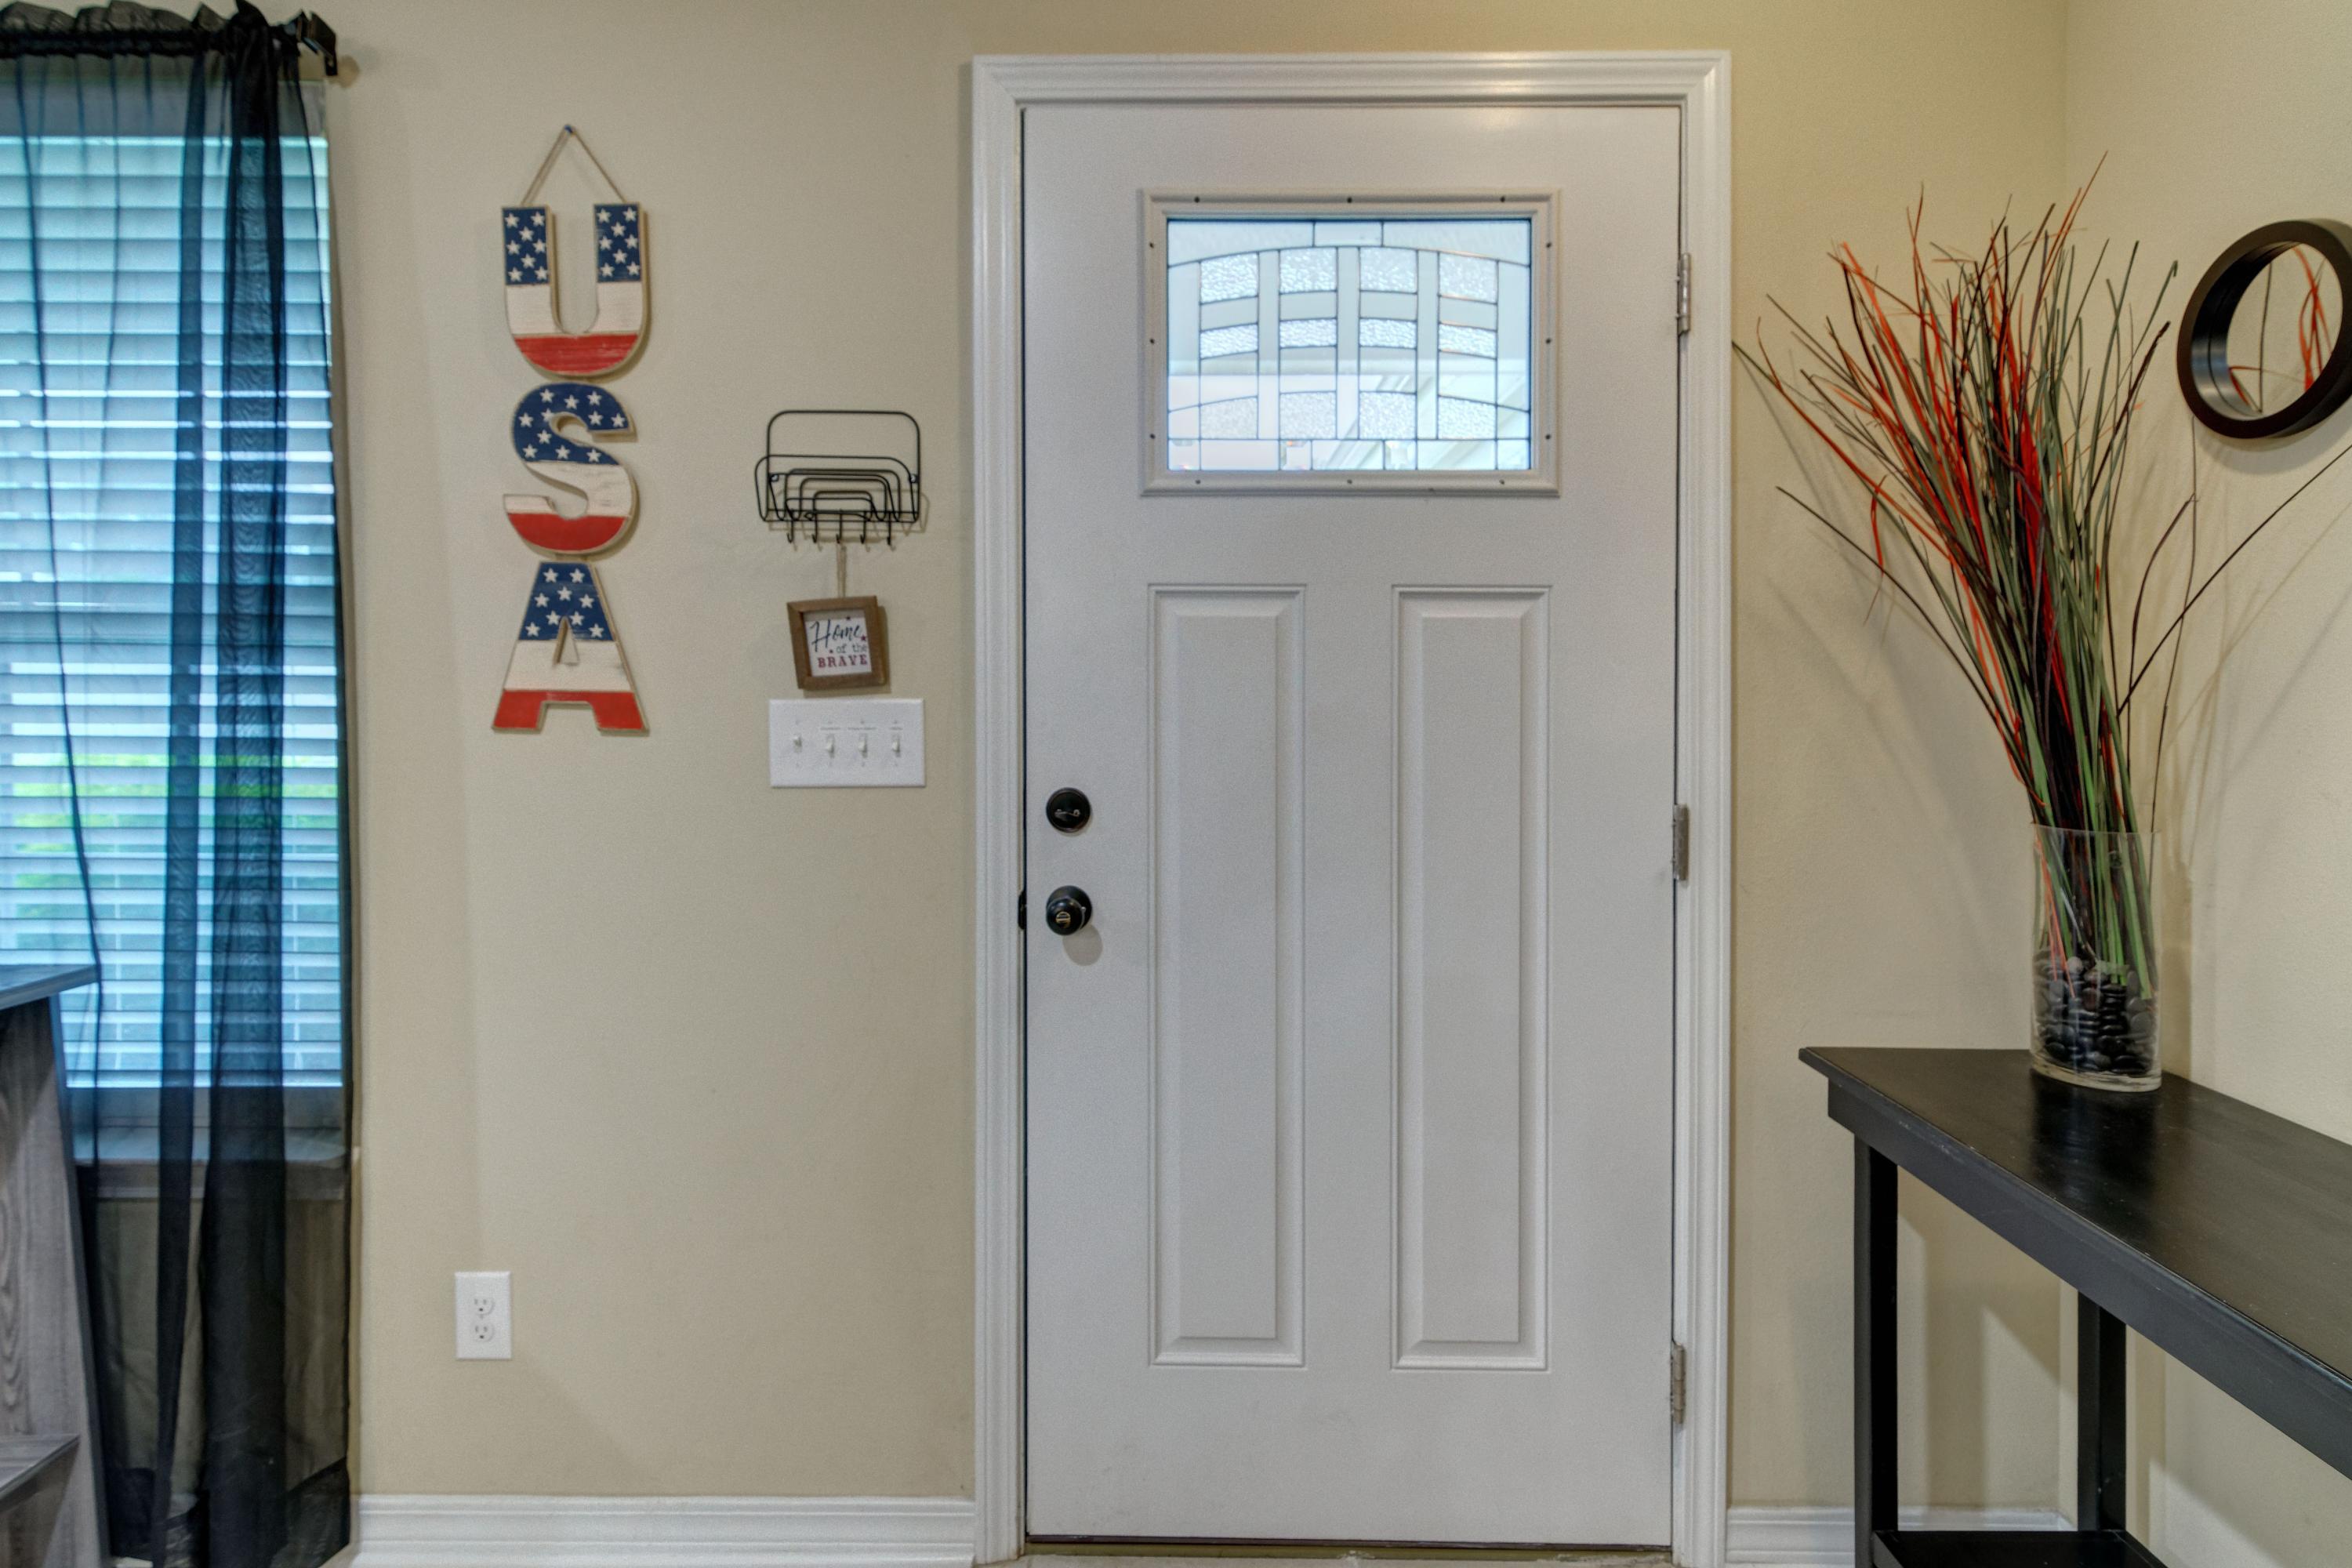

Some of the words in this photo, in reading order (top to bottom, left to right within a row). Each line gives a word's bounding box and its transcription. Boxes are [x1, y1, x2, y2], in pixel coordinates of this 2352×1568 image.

[494, 203, 648, 735] USA
[810, 619, 860, 652] Home
[836, 644, 847, 654] of
[852, 643, 867, 653] the
[817, 654, 867, 668] BRAVE
